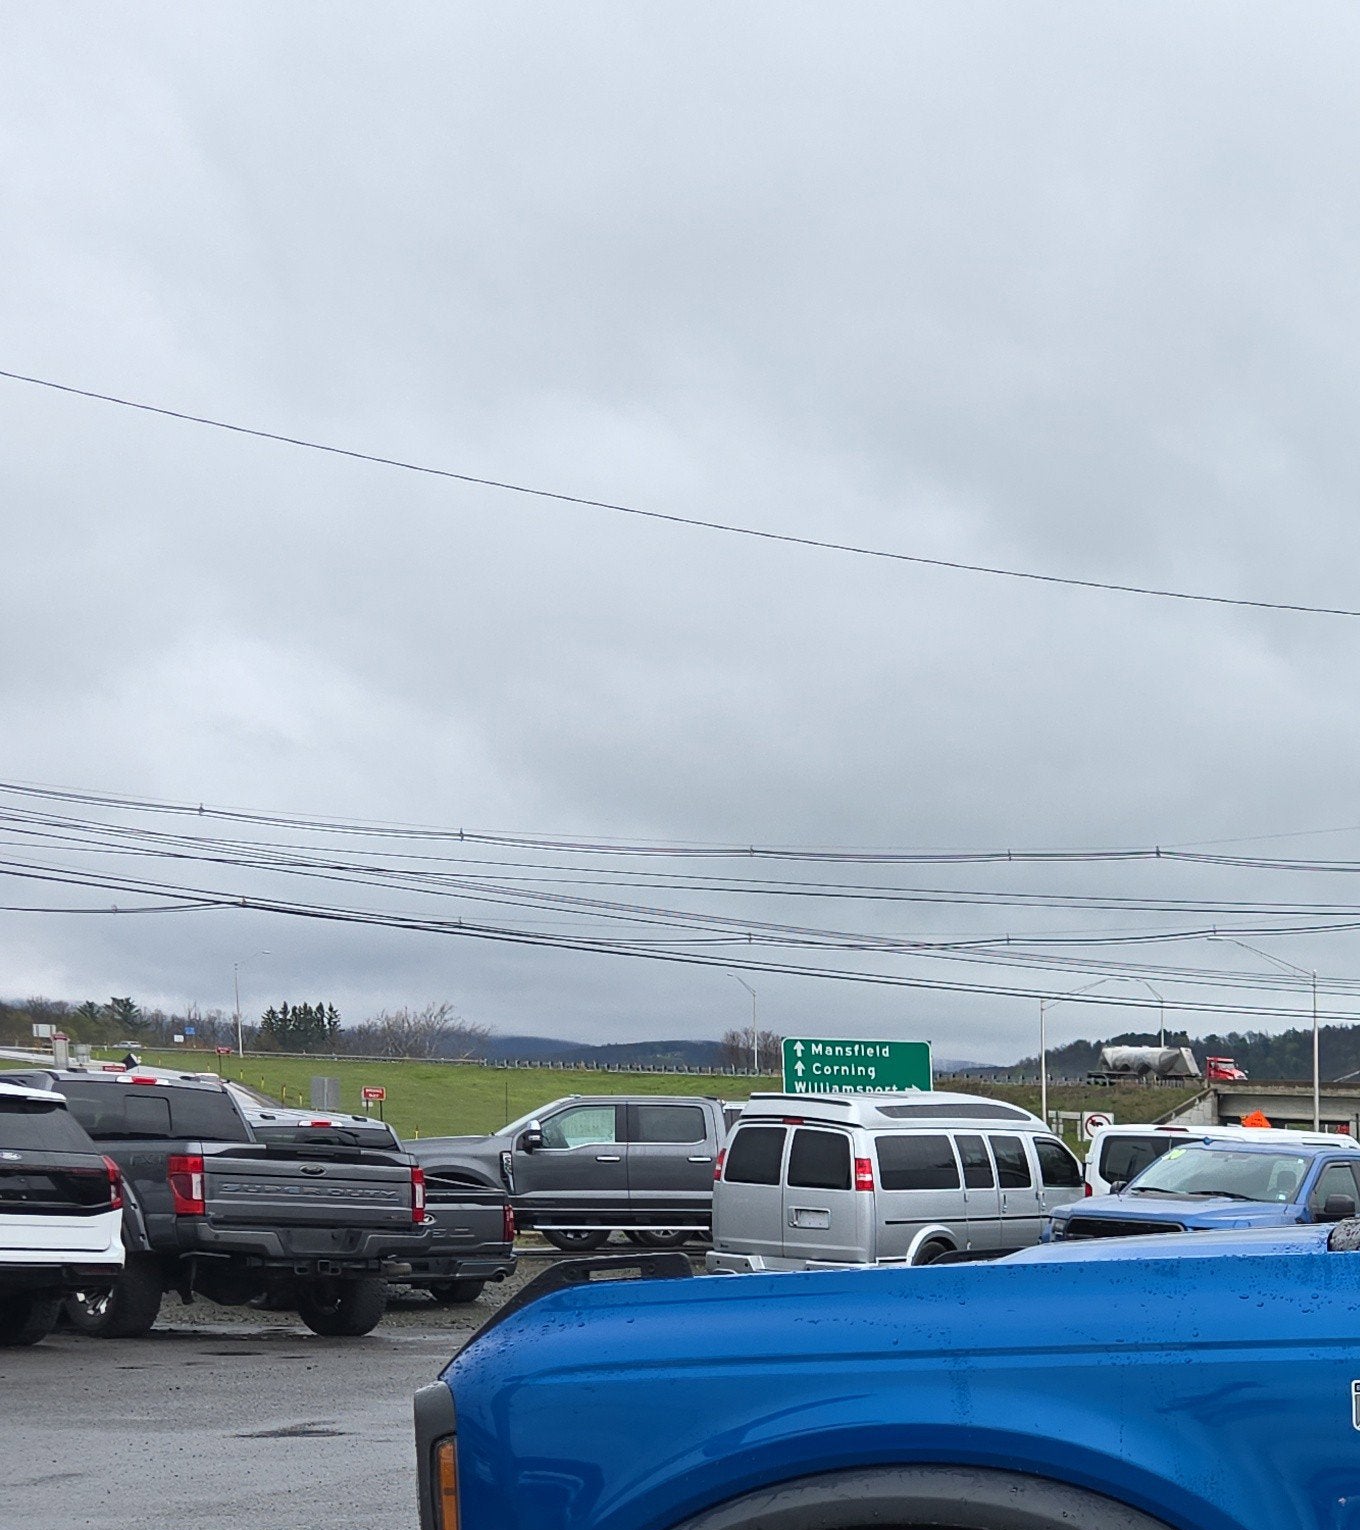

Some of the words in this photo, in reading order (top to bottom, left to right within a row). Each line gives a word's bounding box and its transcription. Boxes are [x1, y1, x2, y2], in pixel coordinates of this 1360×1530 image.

[811, 1043, 890, 1057] Mansfield
[812, 1063, 876, 1079] Corning
[794, 1081, 898, 1093] Williamsport
[221, 1182, 321, 1197] SUPER
[326, 1187, 399, 1199] DUTY
